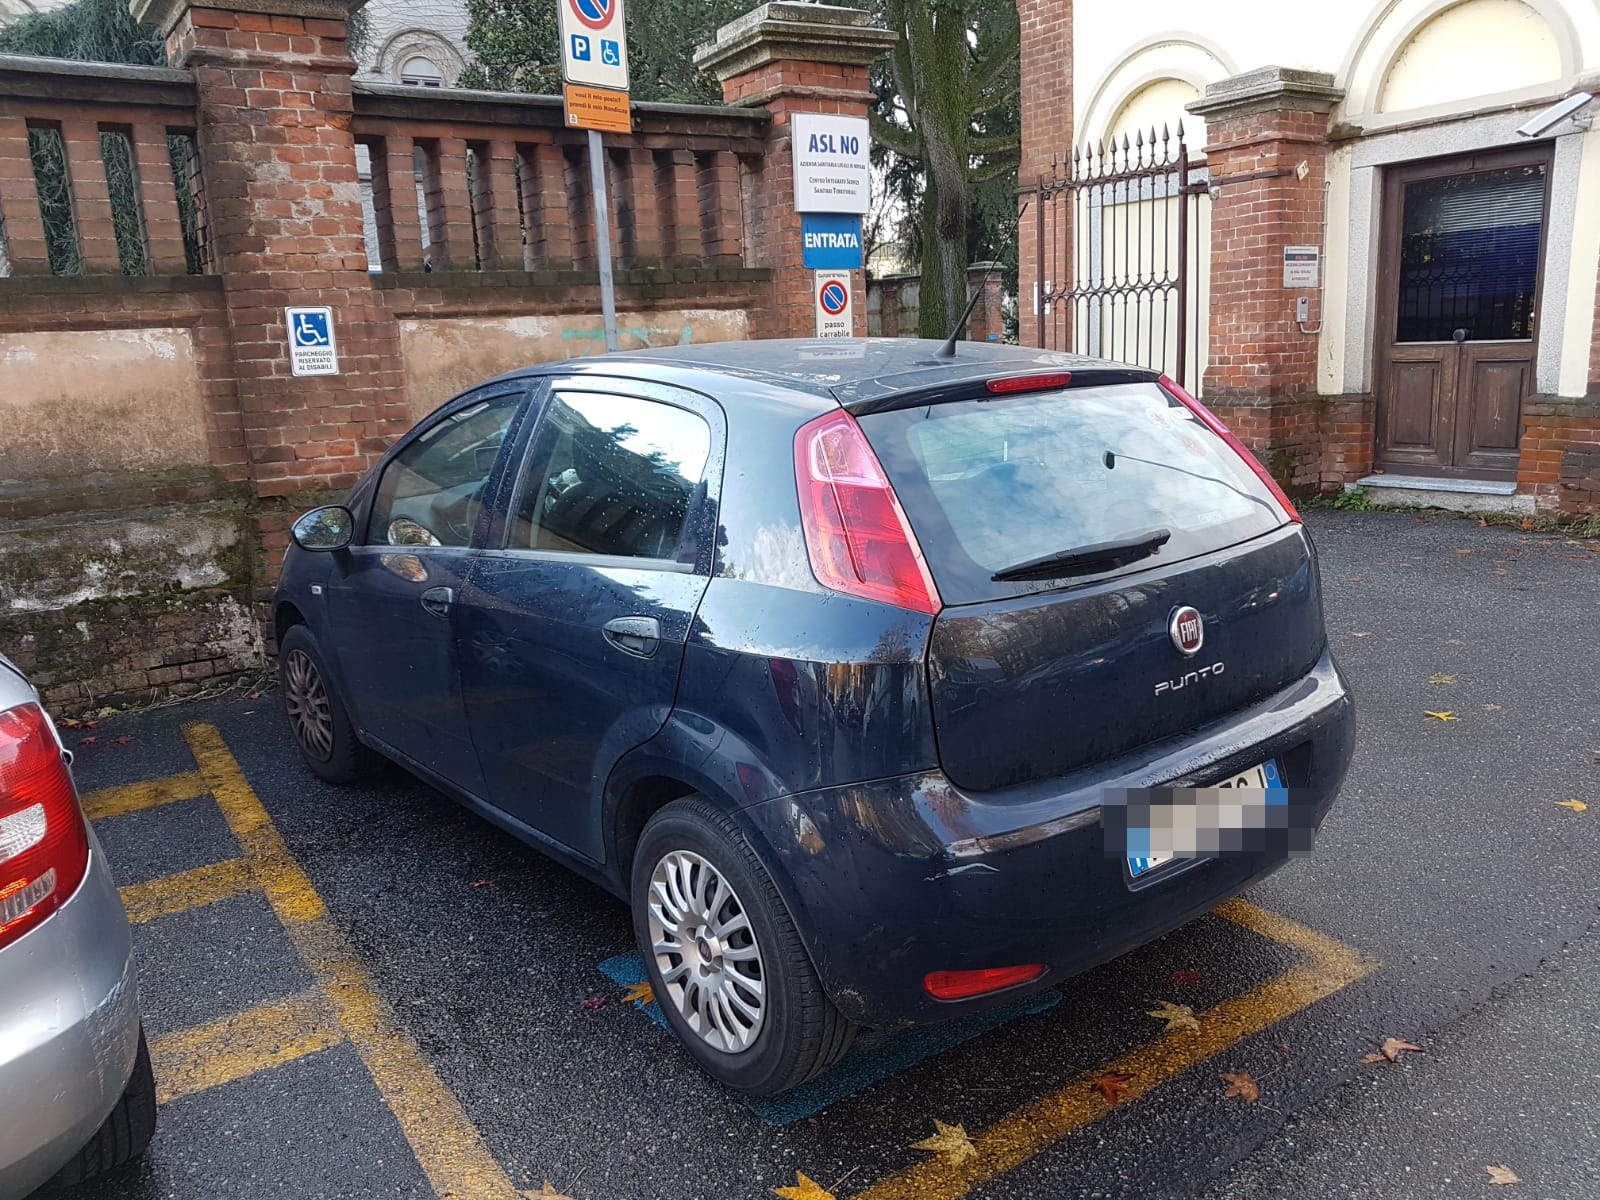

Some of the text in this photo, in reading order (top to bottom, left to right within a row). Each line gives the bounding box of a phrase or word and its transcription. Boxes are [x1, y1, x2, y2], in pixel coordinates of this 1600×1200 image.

[575, 38, 587, 57] P
[808, 133, 859, 155] ASL NO
[804, 232, 859, 249] ENTRATA
[819, 328, 850, 337] carrabile
[824, 321, 845, 330] passo
[295, 350, 333, 358] PARCHEGGIO
[1180, 618, 1198, 644] FIAT
[1154, 662, 1225, 696] PUNTO
